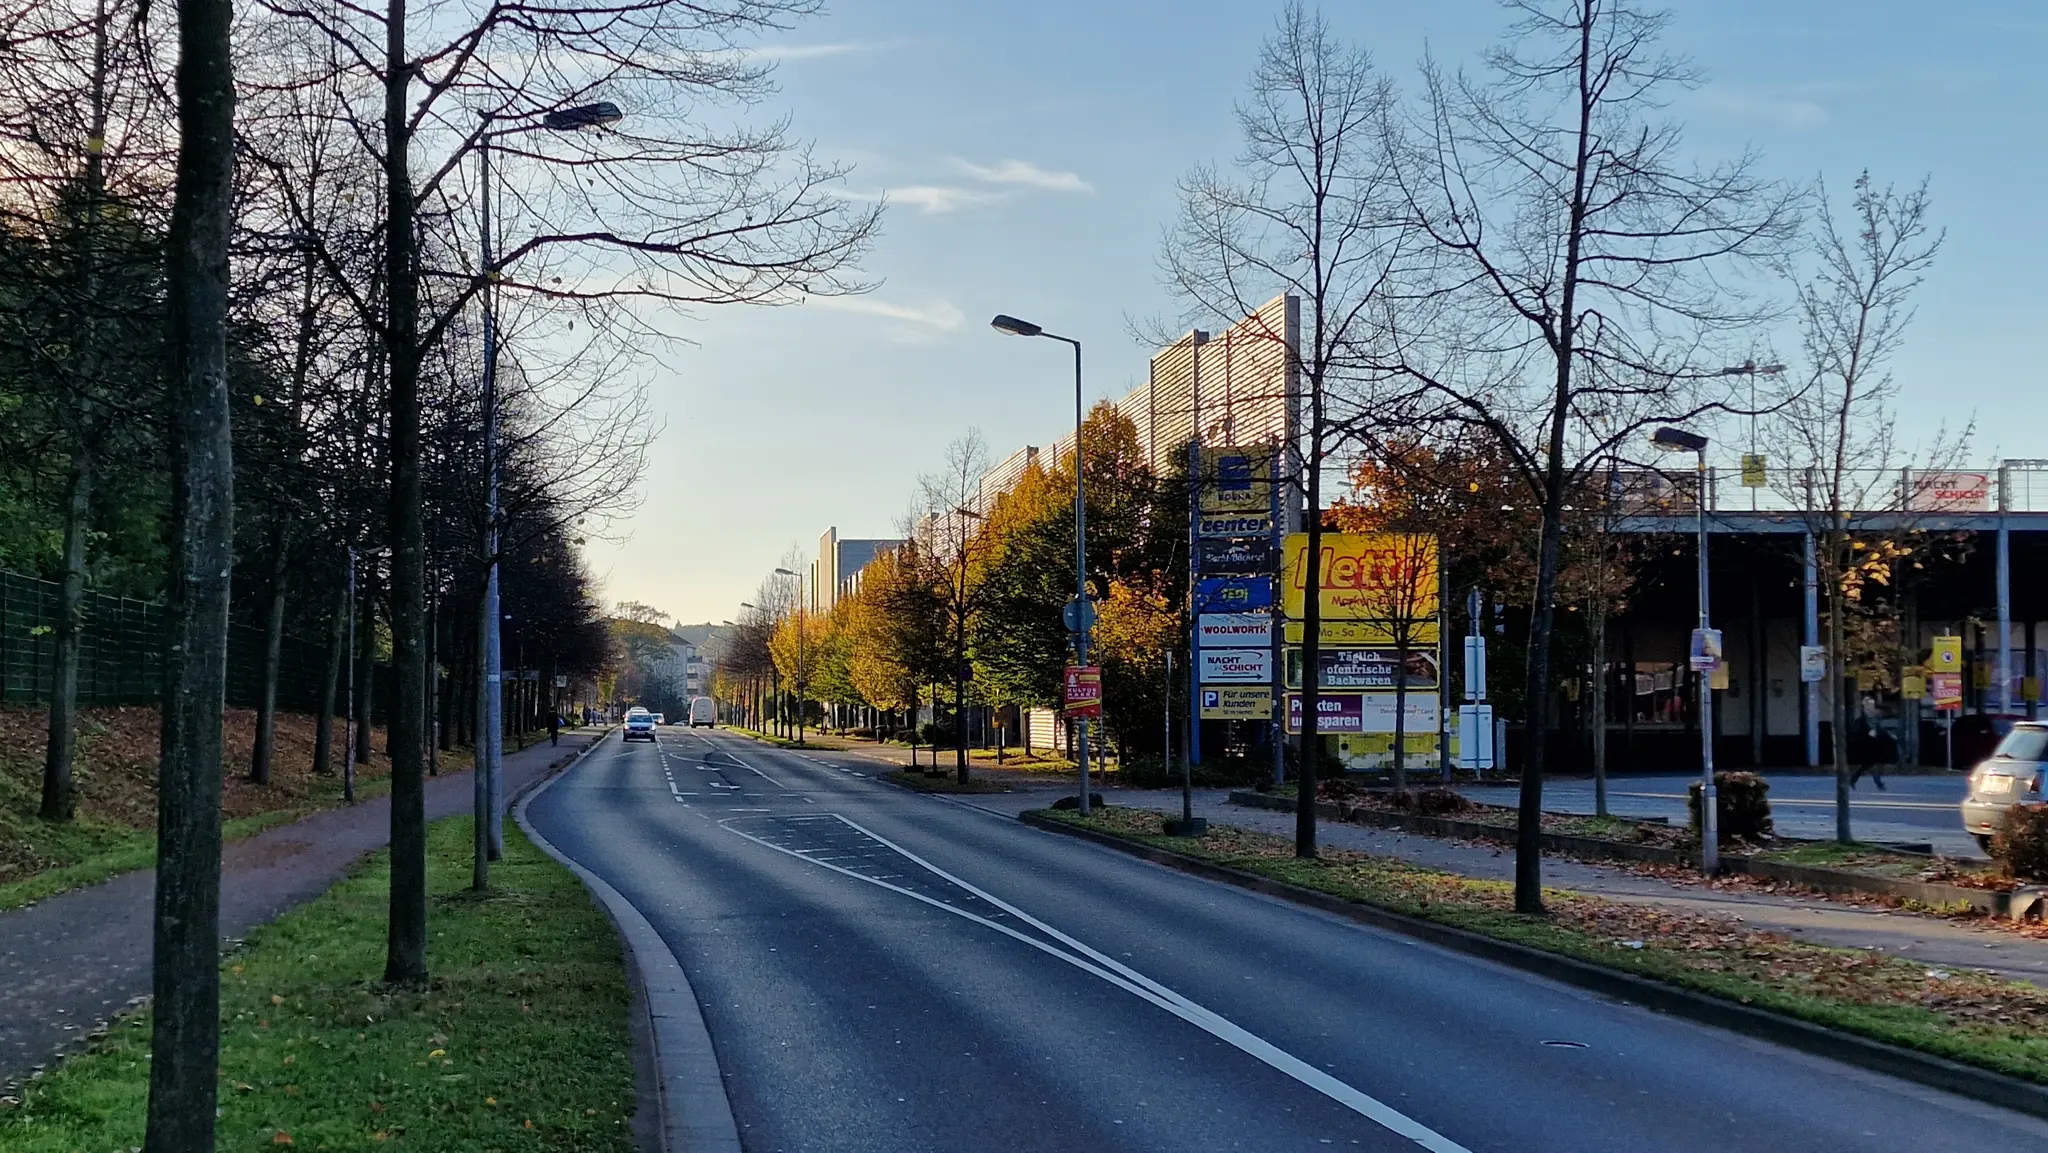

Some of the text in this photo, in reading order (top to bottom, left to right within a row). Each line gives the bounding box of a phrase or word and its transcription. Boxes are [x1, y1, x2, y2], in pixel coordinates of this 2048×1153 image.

[1202, 518, 1267, 532] center
[1208, 656, 1241, 664] NACHT
[1338, 651, 1380, 664] Täglich
[1327, 664, 1392, 674] ofenfrische
[1327, 675, 1392, 685] Backwaren
[1204, 692, 1217, 706] P
[1223, 690, 1238, 698] Für
[1317, 716, 1360, 729] sparen
